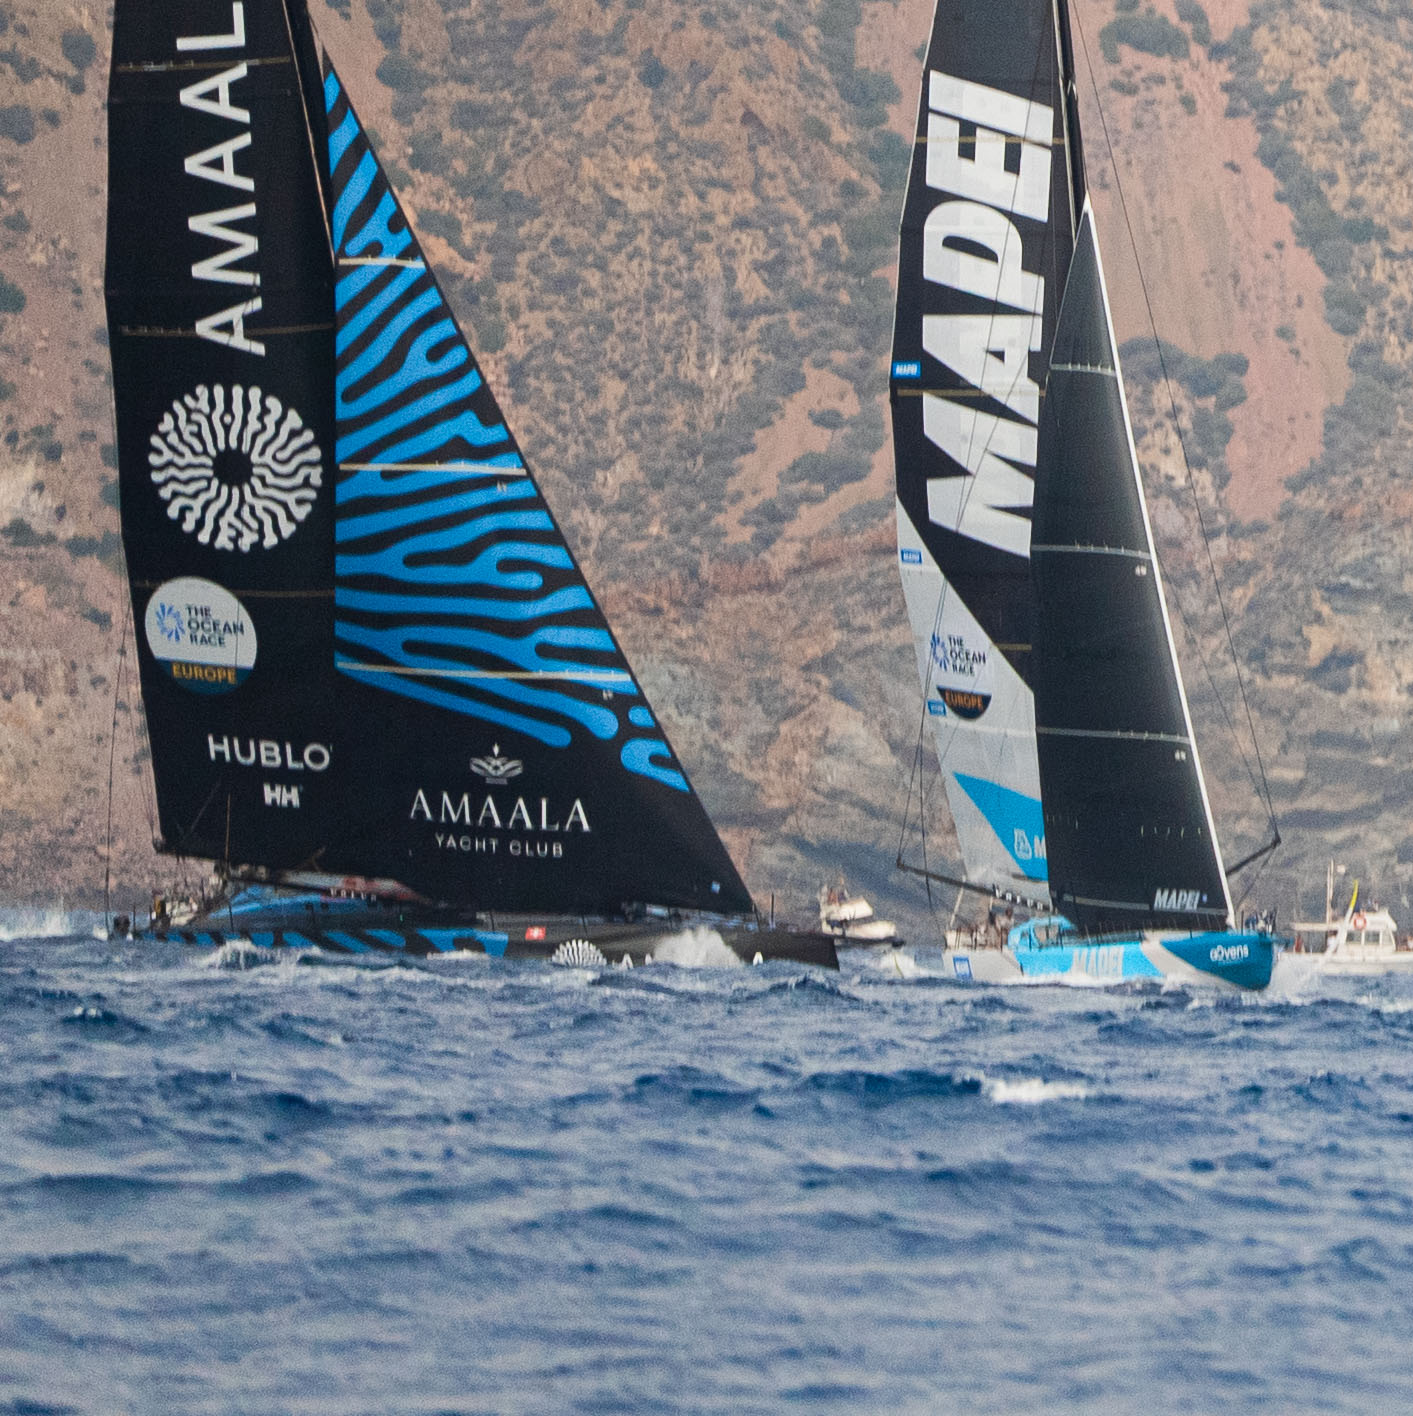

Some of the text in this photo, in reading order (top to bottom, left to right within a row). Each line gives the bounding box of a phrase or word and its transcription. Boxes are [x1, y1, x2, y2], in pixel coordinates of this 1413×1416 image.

[922, 70, 1054, 558] MAPEI
[186, 604, 212, 617] THE
[187, 618, 244, 635] OCEAN
[190, 633, 226, 647] RACE
[948, 635, 964, 649] THE
[950, 647, 986, 664] OCEAN
[172, 662, 237, 684] EUROPE
[952, 662, 975, 676] RACE
[945, 692, 984, 709] EUROPE
[208, 734, 333, 771] HUBLO
[410, 788, 591, 833] AMAALA
[435, 832, 563, 858] YACHT CLUB
[1154, 888, 1201, 911] MAPEI
